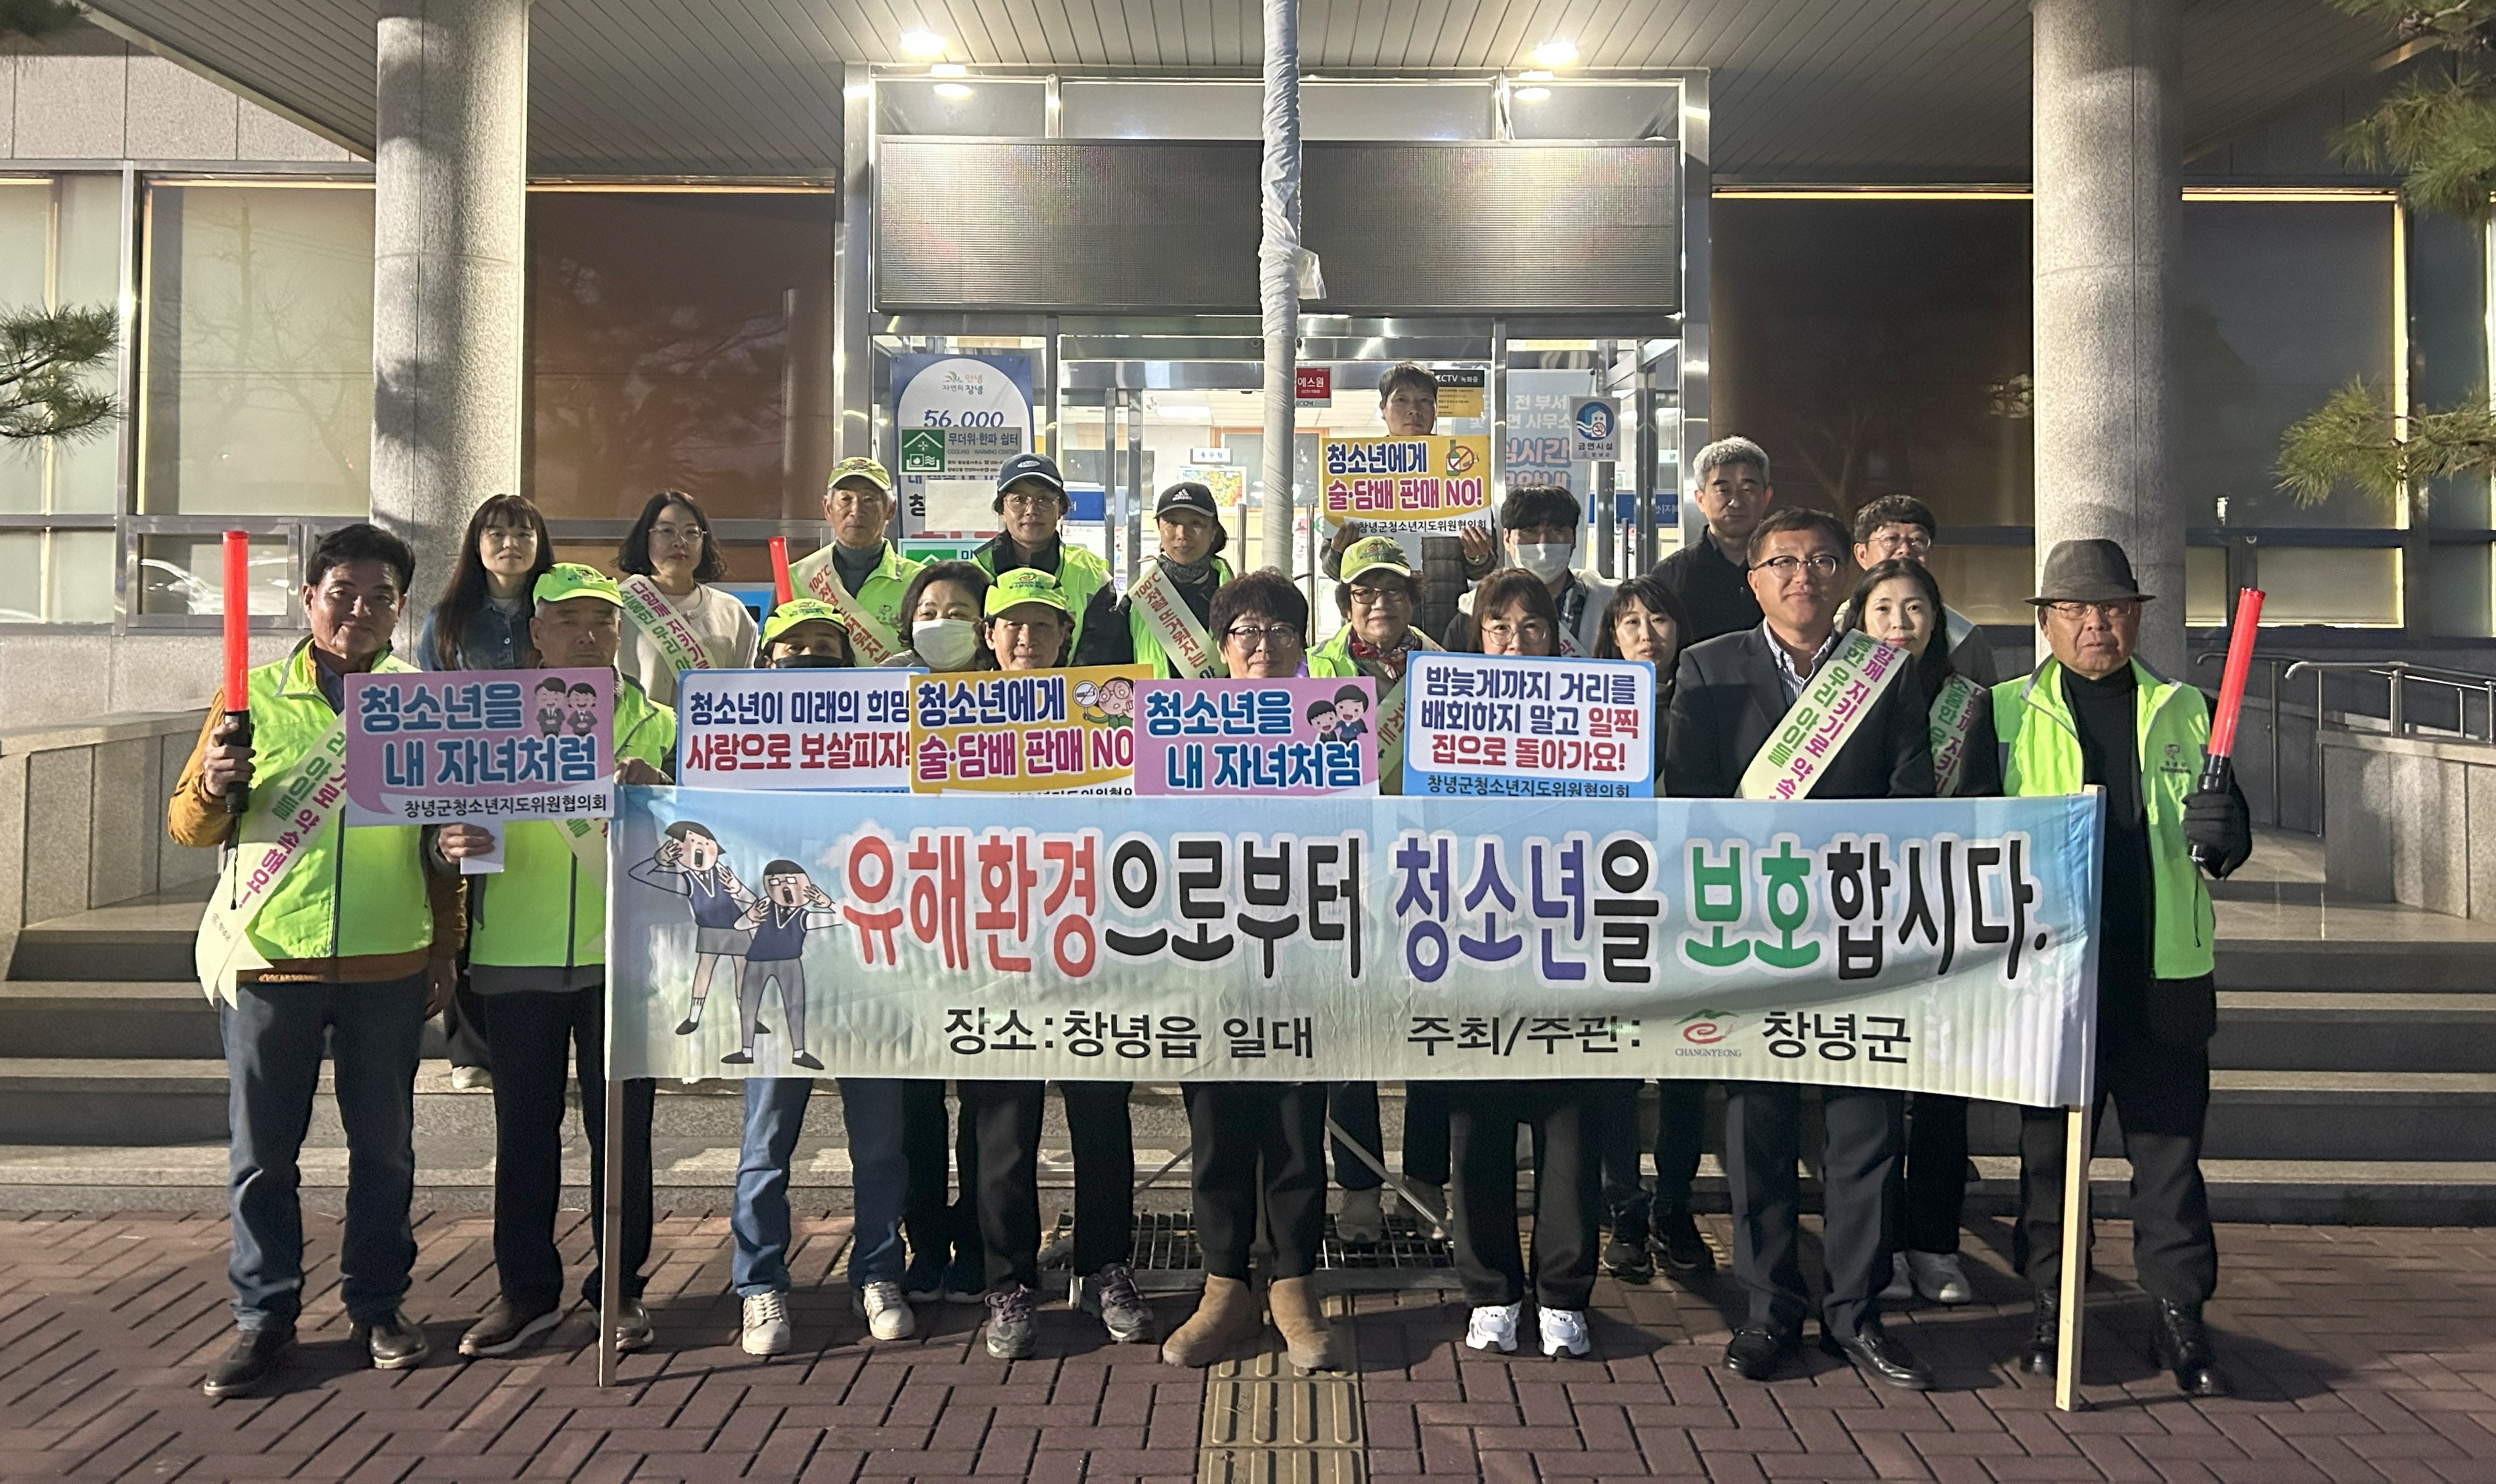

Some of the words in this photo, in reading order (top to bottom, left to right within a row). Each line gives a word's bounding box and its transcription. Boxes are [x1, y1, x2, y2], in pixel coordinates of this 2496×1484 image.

[1297, 377, 1324, 388] 에스원
[1515, 395, 1530, 410] 전
[1535, 394, 1567, 410] 부서
[1000, 433, 1018, 446] 쉼터
[1326, 441, 1427, 475] 청소년에게
[1328, 478, 1393, 510] 술·담배
[1400, 477, 1438, 509] 판매
[1446, 477, 1482, 505] NO!
[630, 580, 671, 617] 다함께
[652, 626, 681, 655] 우리
[1145, 587, 1169, 612] 처럼
[1159, 608, 1208, 668] 뜨거워지는
[917, 677, 1065, 728] 청소년에게
[1427, 667, 1551, 700] 밤늦게까지
[1560, 672, 1635, 705] 거리를
[1813, 666, 1849, 709] 우리
[361, 682, 523, 733] 청소년을
[691, 691, 782, 725] 청소년이
[791, 690, 859, 723] 미래의
[1147, 691, 1292, 736] 청소년을
[1421, 700, 1521, 733] 배회하지
[1531, 705, 1580, 735] 말고
[1588, 707, 1639, 739] 일찍
[1805, 679, 1871, 758] 지키기로
[686, 733, 791, 770] 사랑으로
[800, 731, 910, 768] 보살피자!
[918, 731, 1016, 780] 술·담배
[1025, 728, 1083, 774] 판매
[1432, 734, 1507, 765] 집으로
[1515, 738, 1625, 772] 돌아가요!
[1767, 707, 1820, 768] 아이들
[385, 743, 424, 787] 내
[439, 735, 596, 785] 자녀처럼
[1168, 745, 1202, 787] 내
[1217, 743, 1361, 787] 자녀처럼
[1769, 757, 1814, 799] 약속
[272, 756, 332, 821] 아이들
[404, 794, 607, 818] 창녕군청소년지도위원협의회
[1428, 775, 1629, 797] 창녕군청소년지도위원협의회
[239, 809, 320, 908] 약속해요!
[844, 835, 1362, 979] 유해환경으로부터
[1396, 837, 1659, 983] 청소년을
[1685, 839, 2047, 980] 보호합시다.
[1223, 1016, 1313, 1058] 일대
[1407, 1016, 1640, 1057] 주최/주관:
[1762, 1011, 1911, 1064] 창녕군
[1675, 1048, 1742, 1058] CHANGNYEONG
